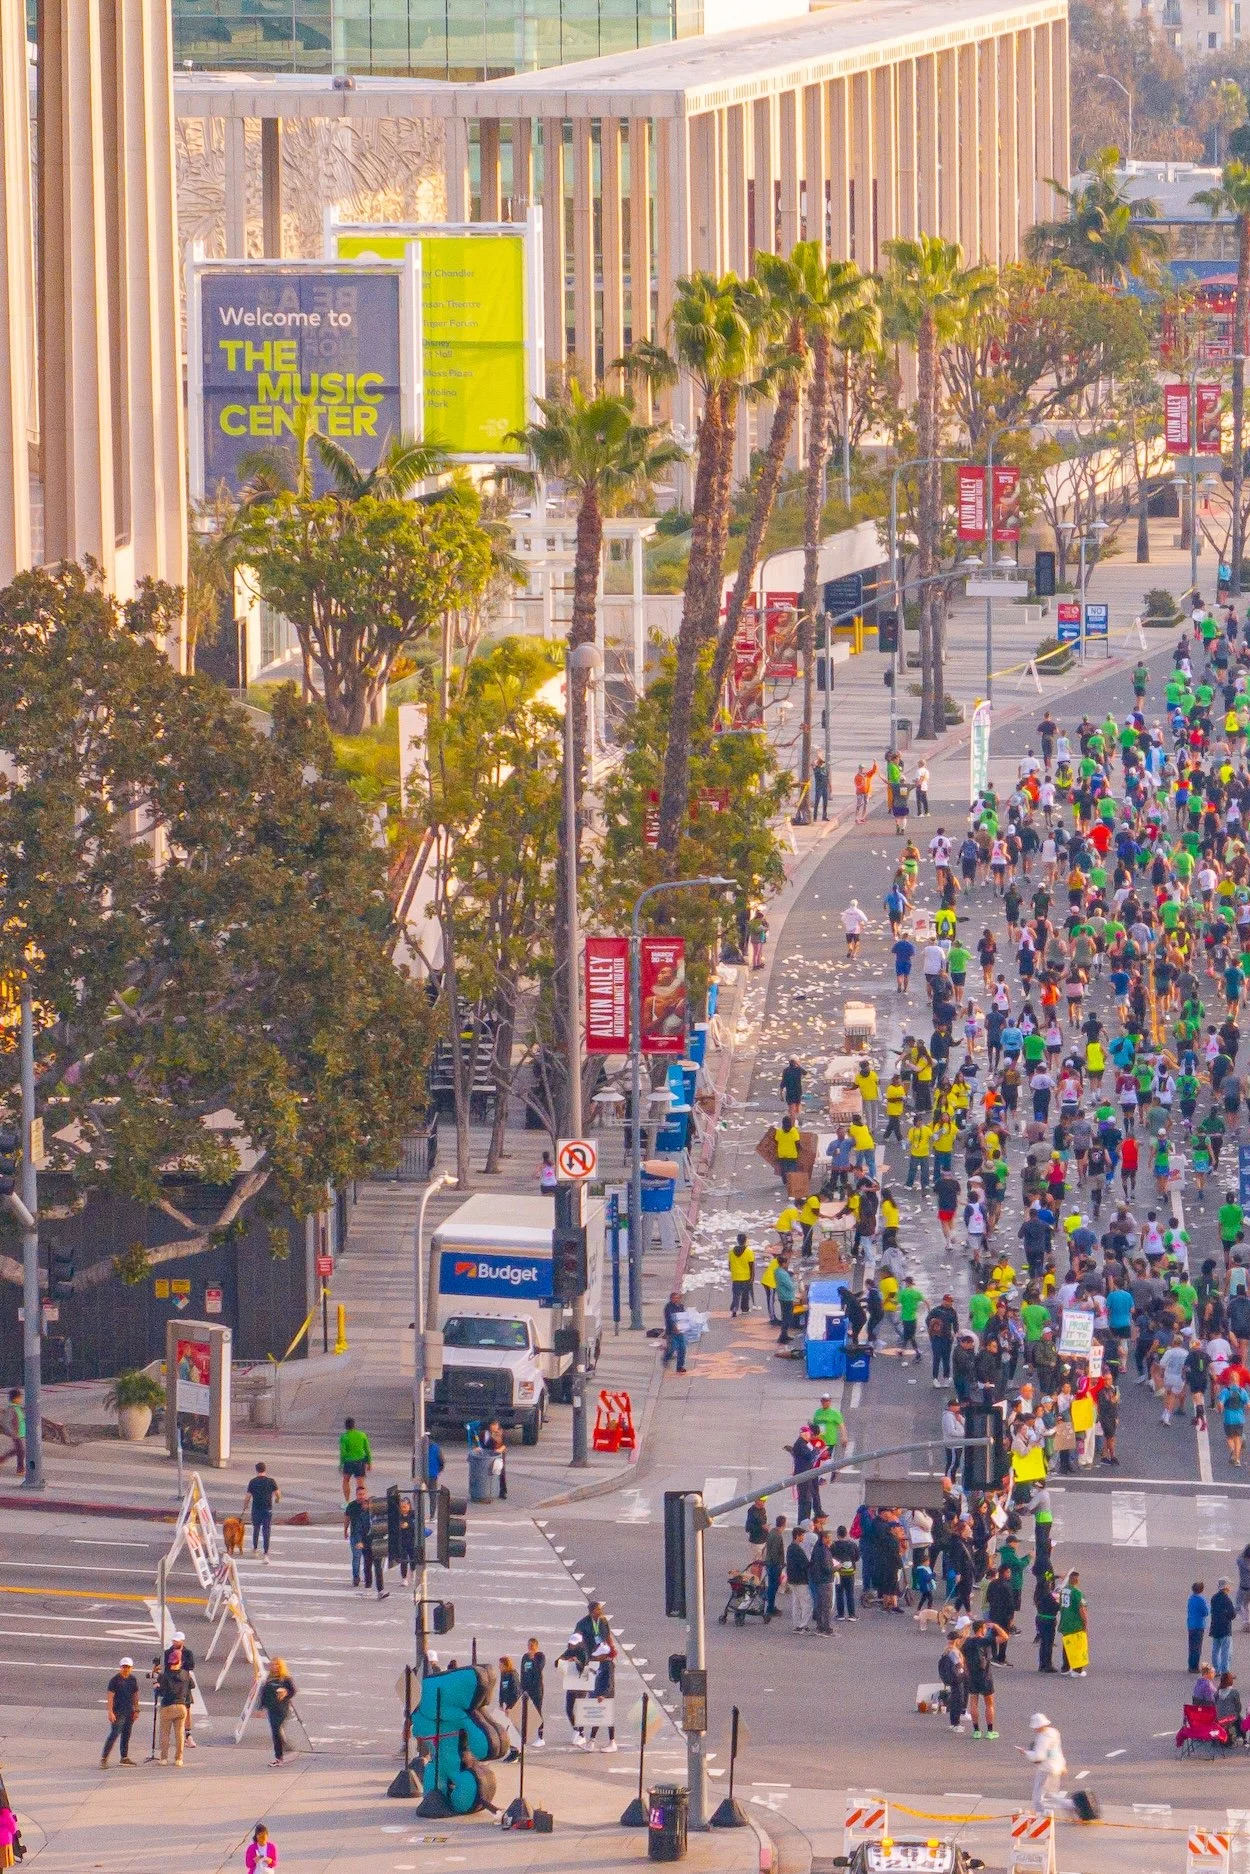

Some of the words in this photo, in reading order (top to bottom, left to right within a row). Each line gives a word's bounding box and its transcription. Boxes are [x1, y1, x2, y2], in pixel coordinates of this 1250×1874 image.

[434, 269, 475, 278] Chandler
[219, 307, 321, 326] Welcome
[329, 309, 352, 326] to
[219, 340, 298, 371] THE
[258, 372, 385, 404] MUSIC
[1168, 395, 1181, 418] AILEY
[219, 404, 378, 436] CENTER
[1168, 420, 1181, 442] ALVIN
[961, 477, 976, 502] AILEY
[961, 504, 976, 529] ALVIN
[1091, 607, 1103, 615] NO
[589, 956, 613, 995] AILEY
[613, 957, 625, 984] THEATER
[613, 985, 625, 1005] DANCE
[589, 999, 613, 1037] ALVIN
[613, 1006, 625, 1038] AMERICAN
[478, 1263, 538, 1285] Budget
